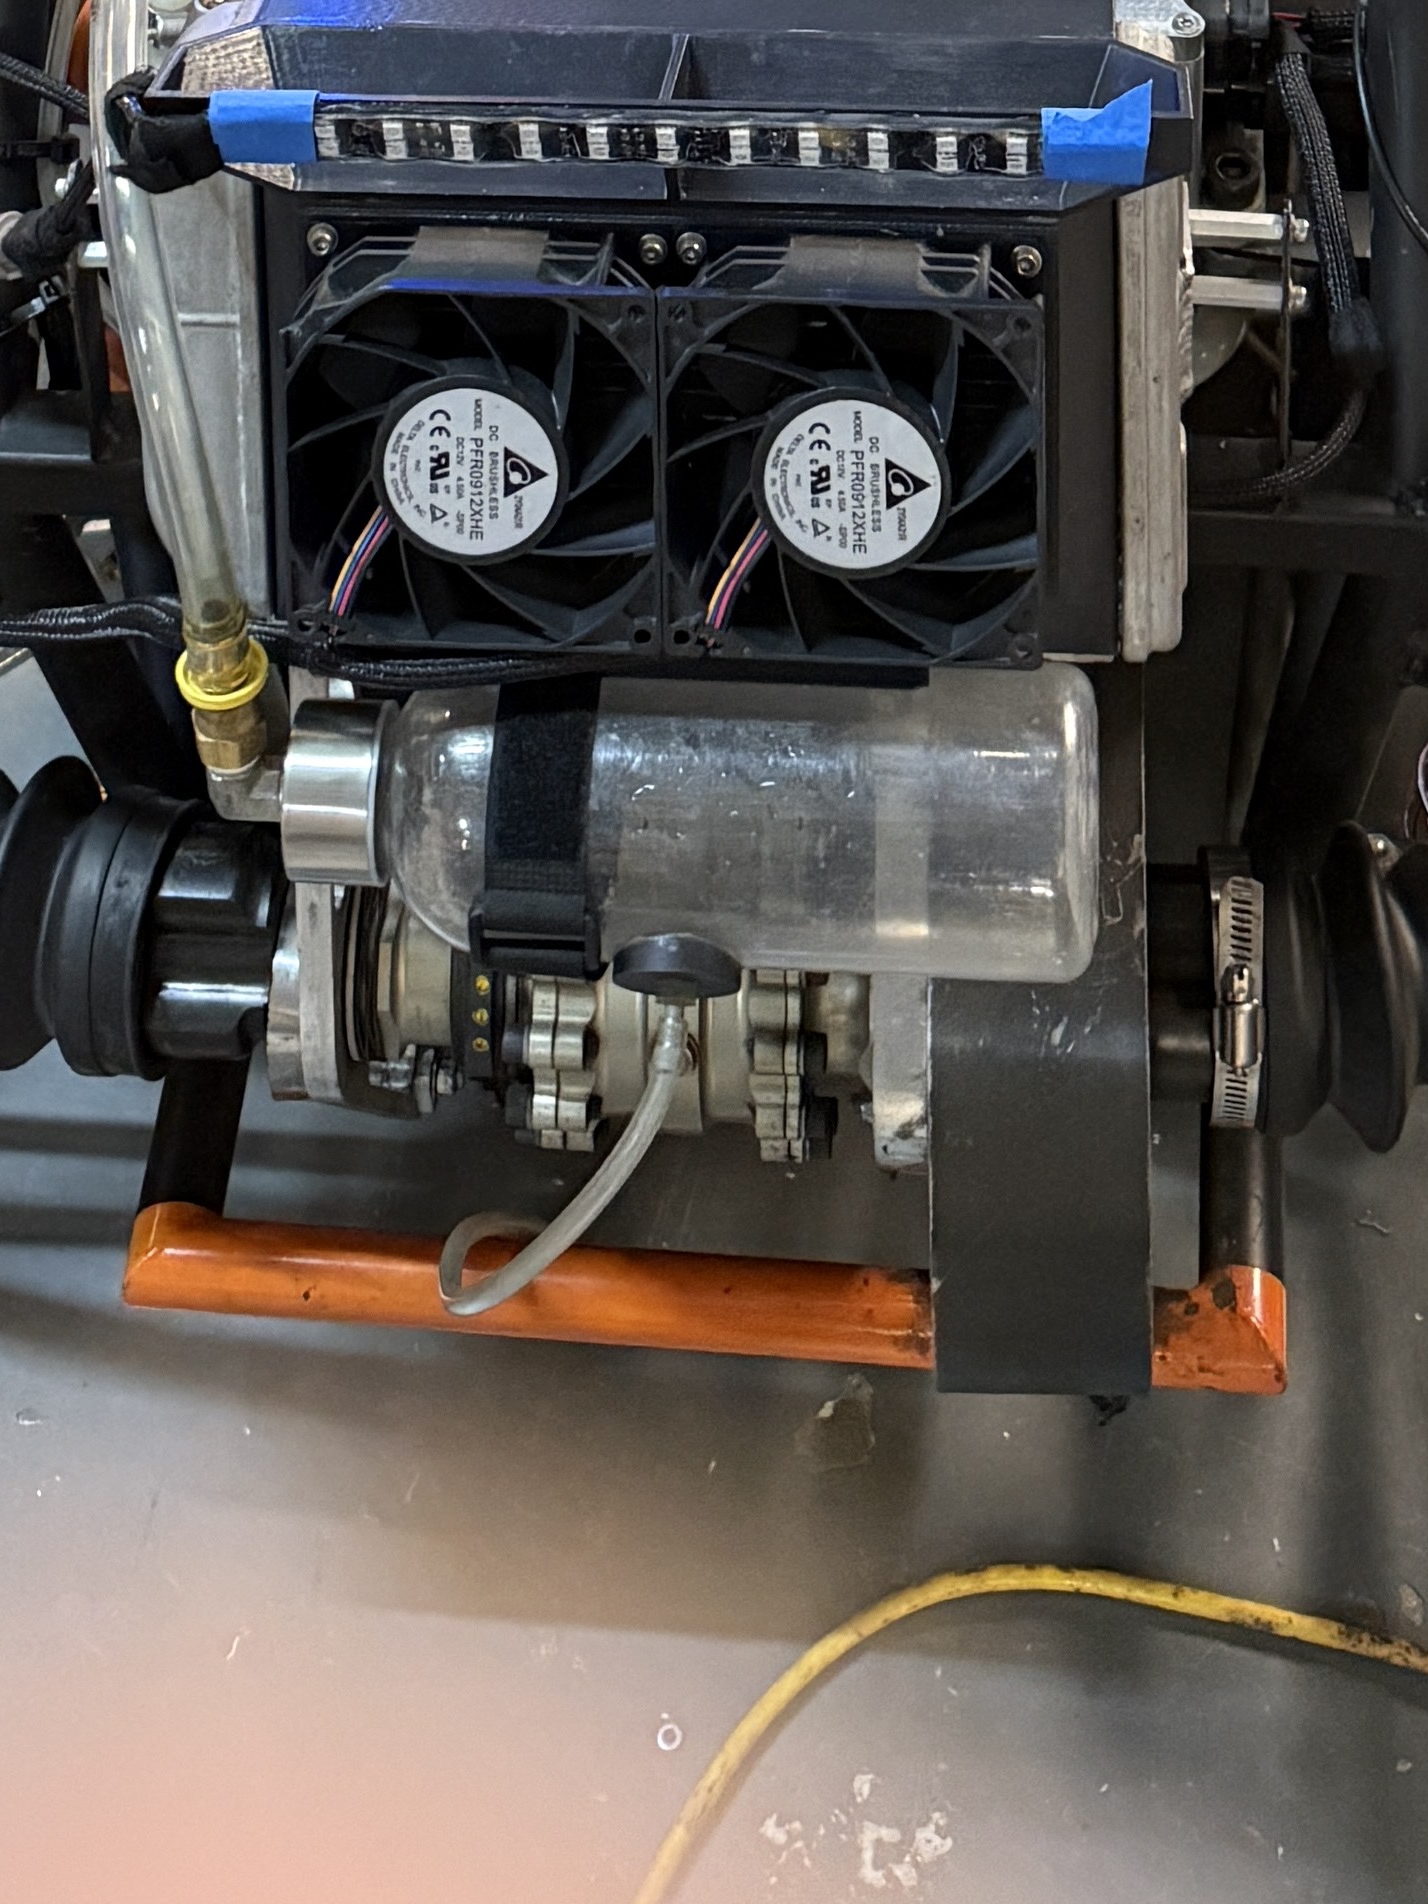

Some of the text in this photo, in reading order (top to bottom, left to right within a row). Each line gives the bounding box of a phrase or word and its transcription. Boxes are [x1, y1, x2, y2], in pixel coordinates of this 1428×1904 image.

[470, 398, 484, 540] MODEL PFR0912XHE
[489, 425, 499, 520] DC BRUSHLESS
[850, 410, 867, 554] MODEL PFR0912XHE
[869, 437, 881, 533] DC BRUSHLESS
